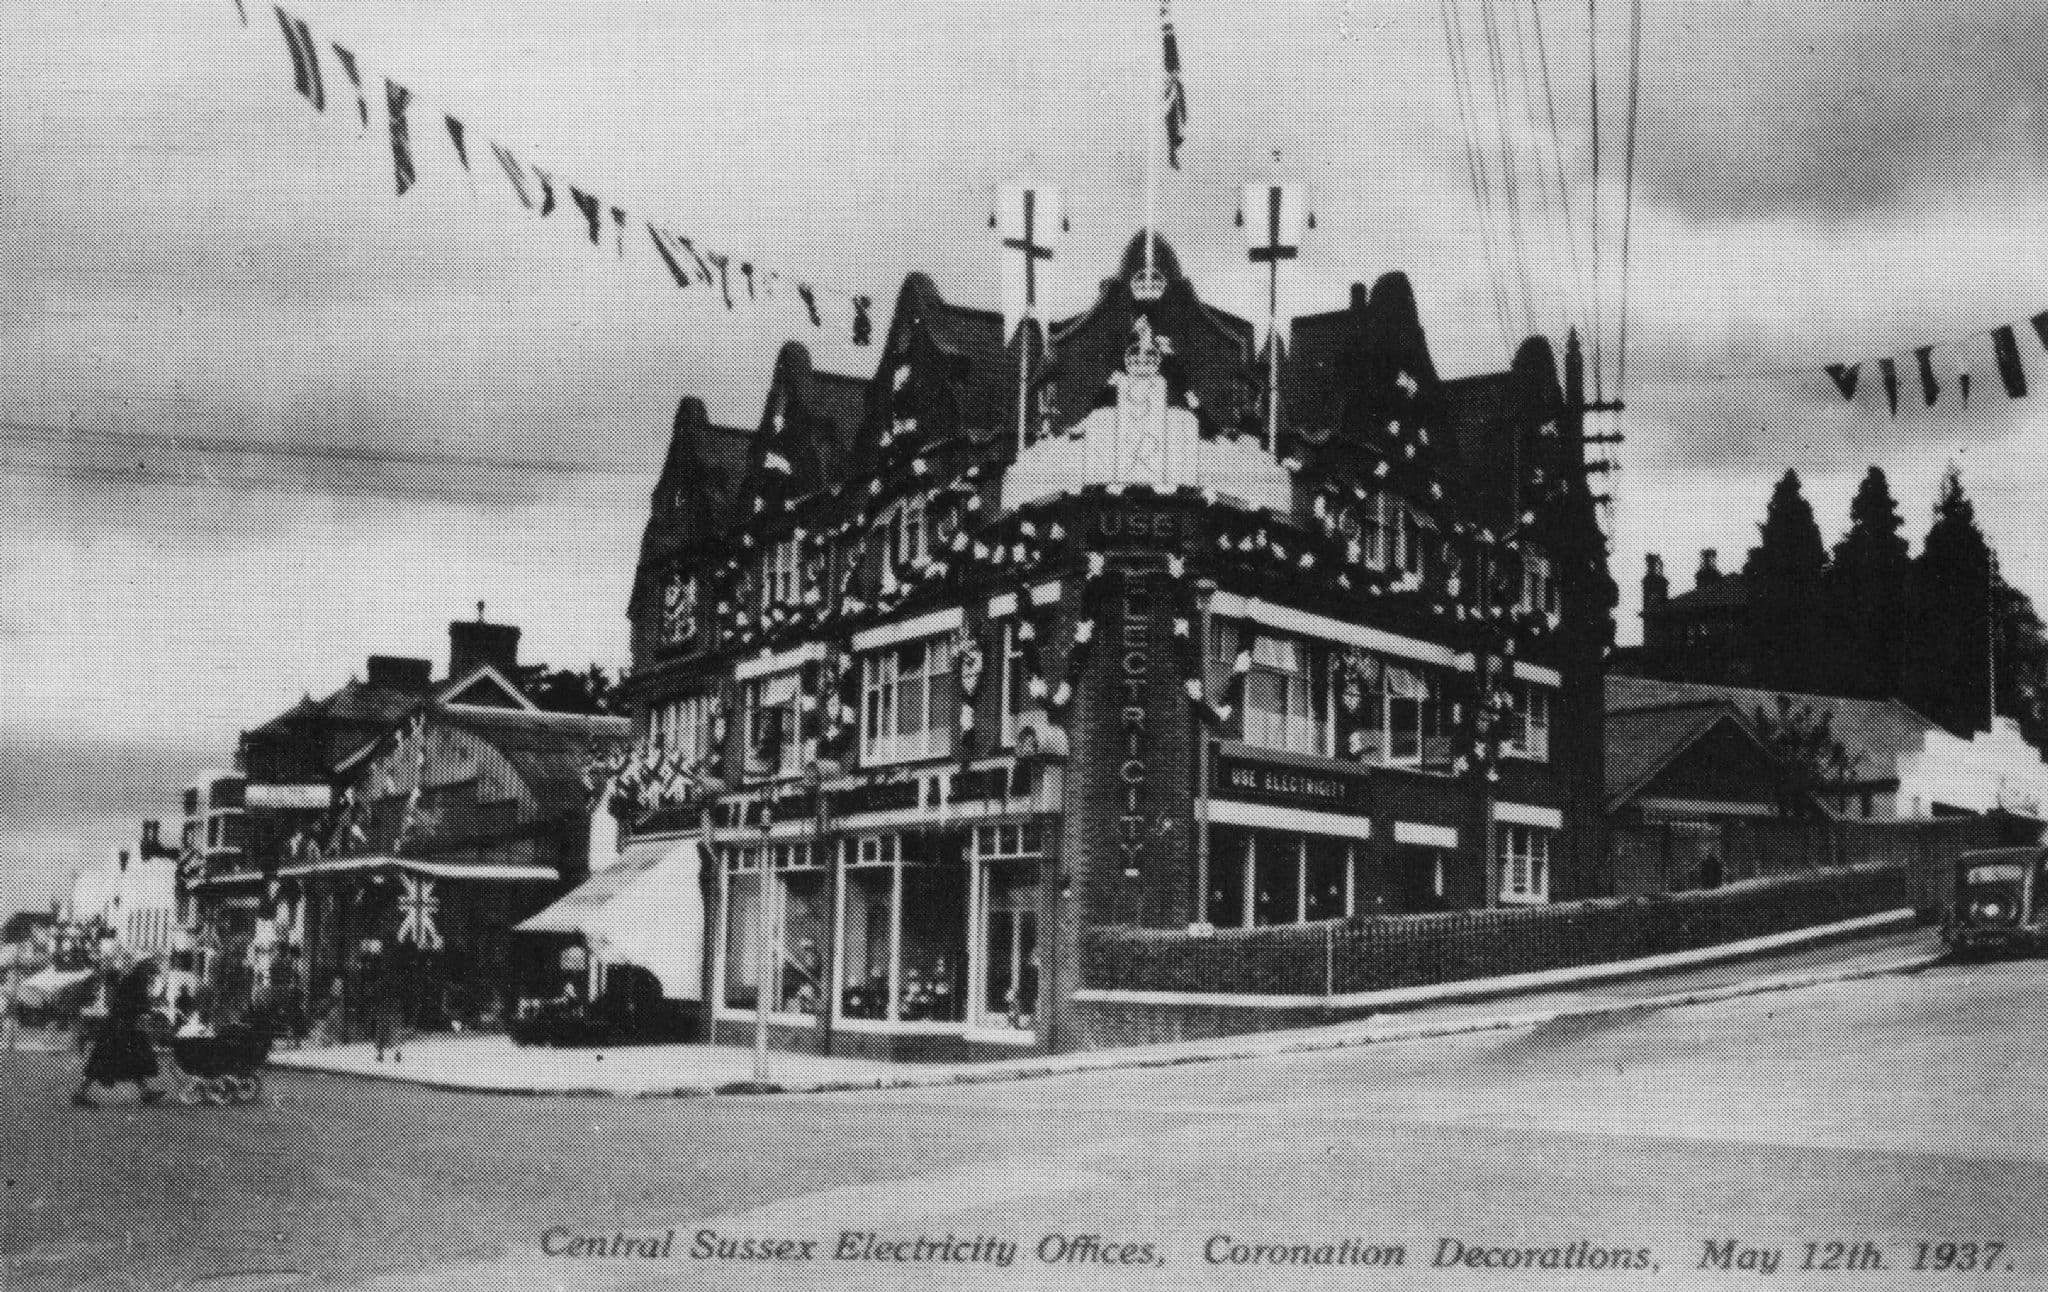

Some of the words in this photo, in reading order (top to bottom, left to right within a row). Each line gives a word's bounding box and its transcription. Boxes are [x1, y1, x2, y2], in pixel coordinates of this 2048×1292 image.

[1099, 512, 1175, 537] USE
[1120, 569, 1149, 866] ELECTRICITY
[1231, 768, 1258, 788] USE
